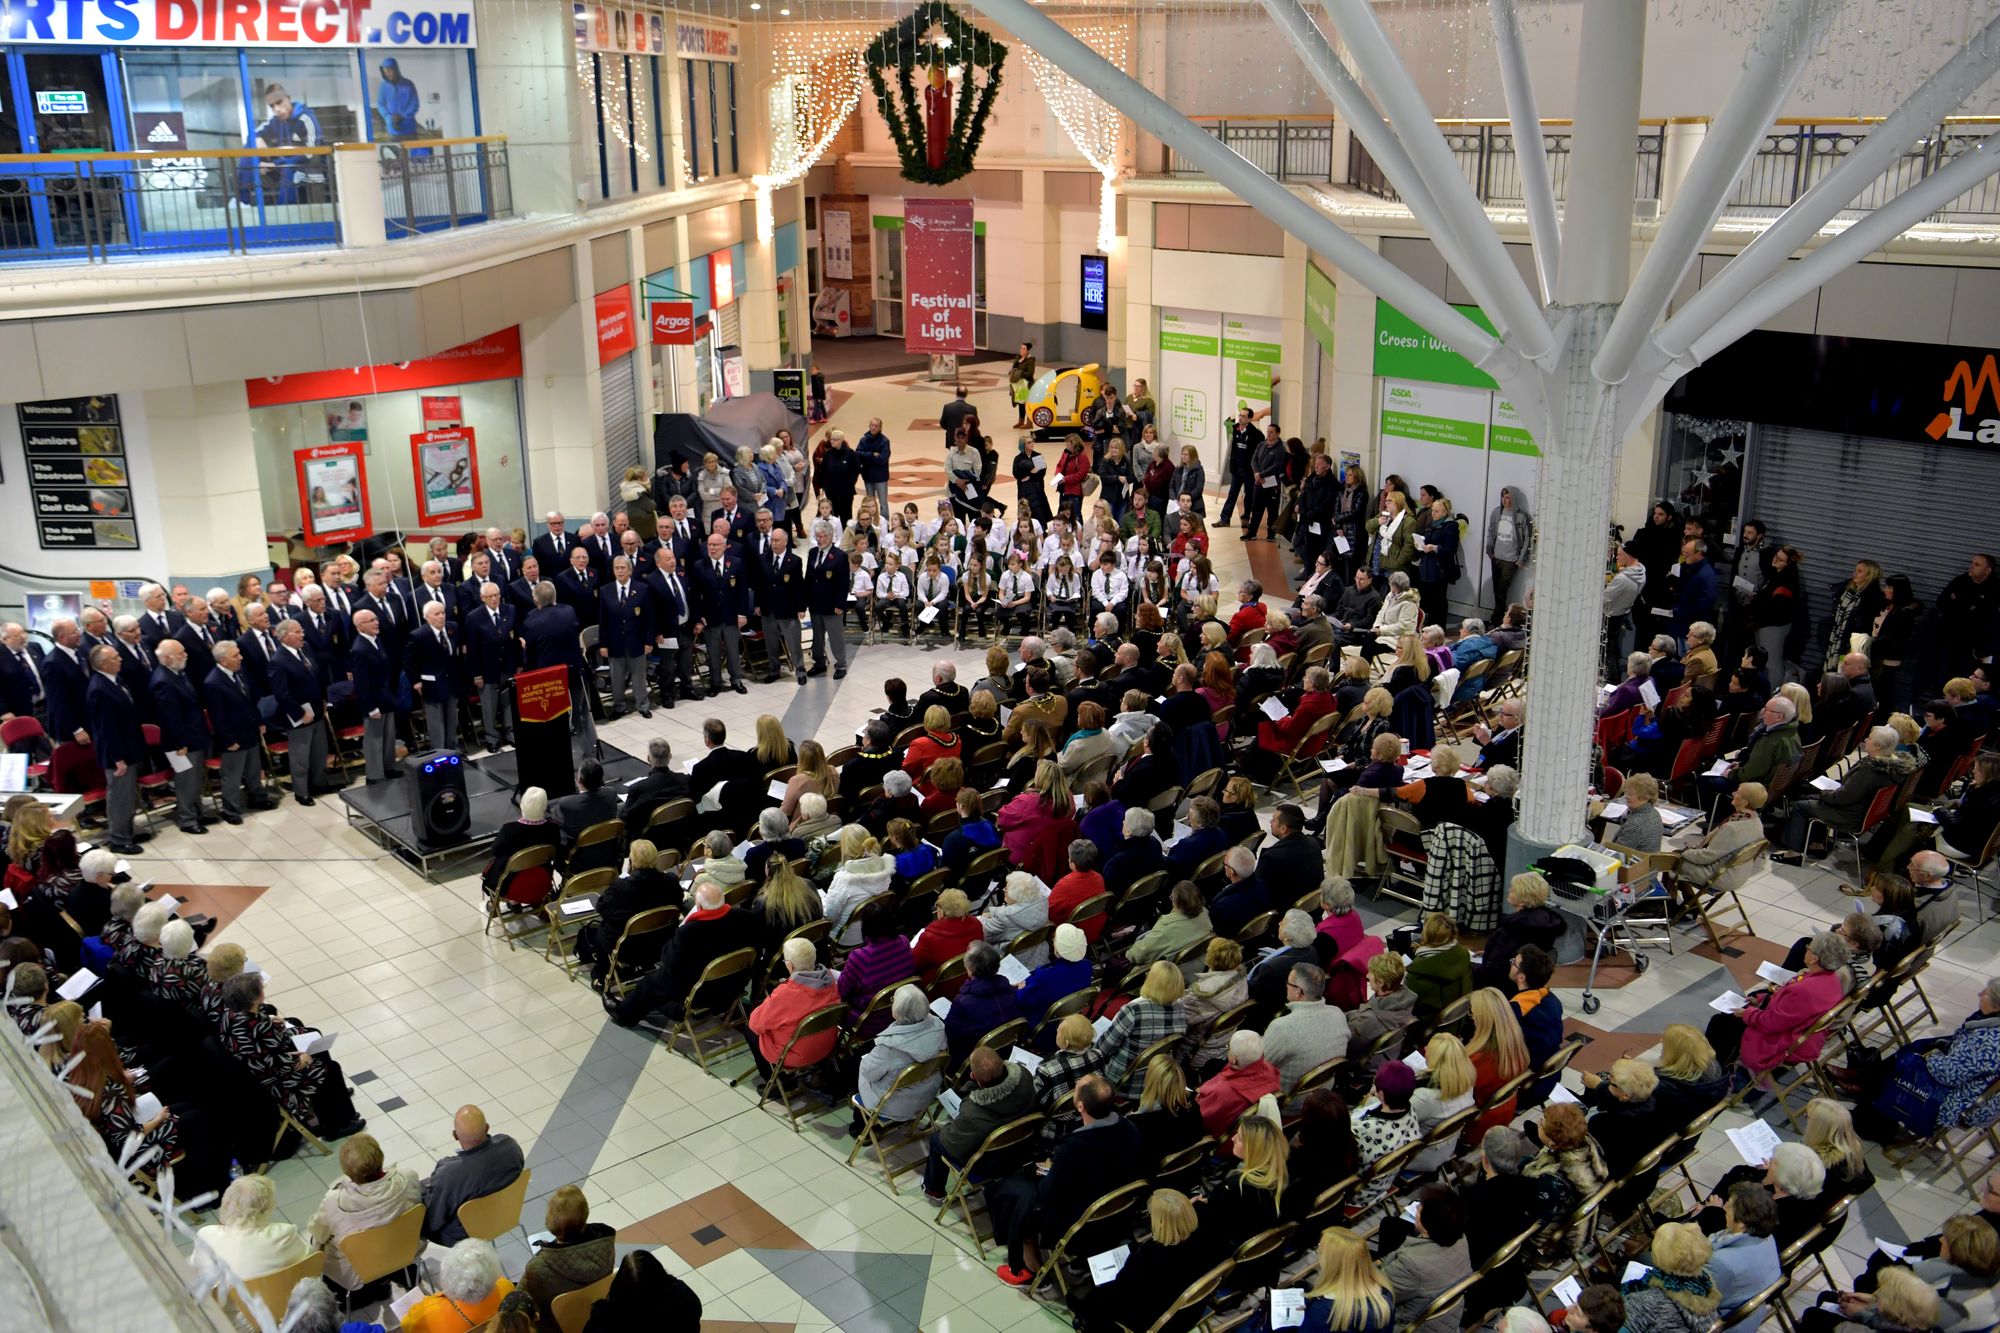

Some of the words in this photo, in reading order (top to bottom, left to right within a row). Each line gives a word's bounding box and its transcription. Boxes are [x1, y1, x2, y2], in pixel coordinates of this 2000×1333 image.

[0, 0, 140, 41] RTS
[911, 293, 971, 309] Festival
[1085, 289, 1104, 303] HERE
[655, 314, 691, 329] Argos
[933, 309, 950, 323] of
[921, 324, 962, 342] Light
[1379, 330, 1418, 348] Croeso
[1422, 335, 1426, 348] i
[1390, 387, 1412, 398] ASDA
[1389, 398, 1422, 409] Pharmacy
[23, 405, 73, 414] Womens
[1412, 420, 1444, 430] Pharmacist
[1386, 424, 1405, 432] advice
[1407, 427, 1424, 435] about
[1438, 432, 1468, 442] medicines
[29, 436, 78, 446] Juniors
[33, 463, 53, 471] The
[34, 472, 84, 480] Bootroom
[38, 494, 59, 502] The
[40, 504, 62, 512] Golf
[64, 504, 89, 512] Club
